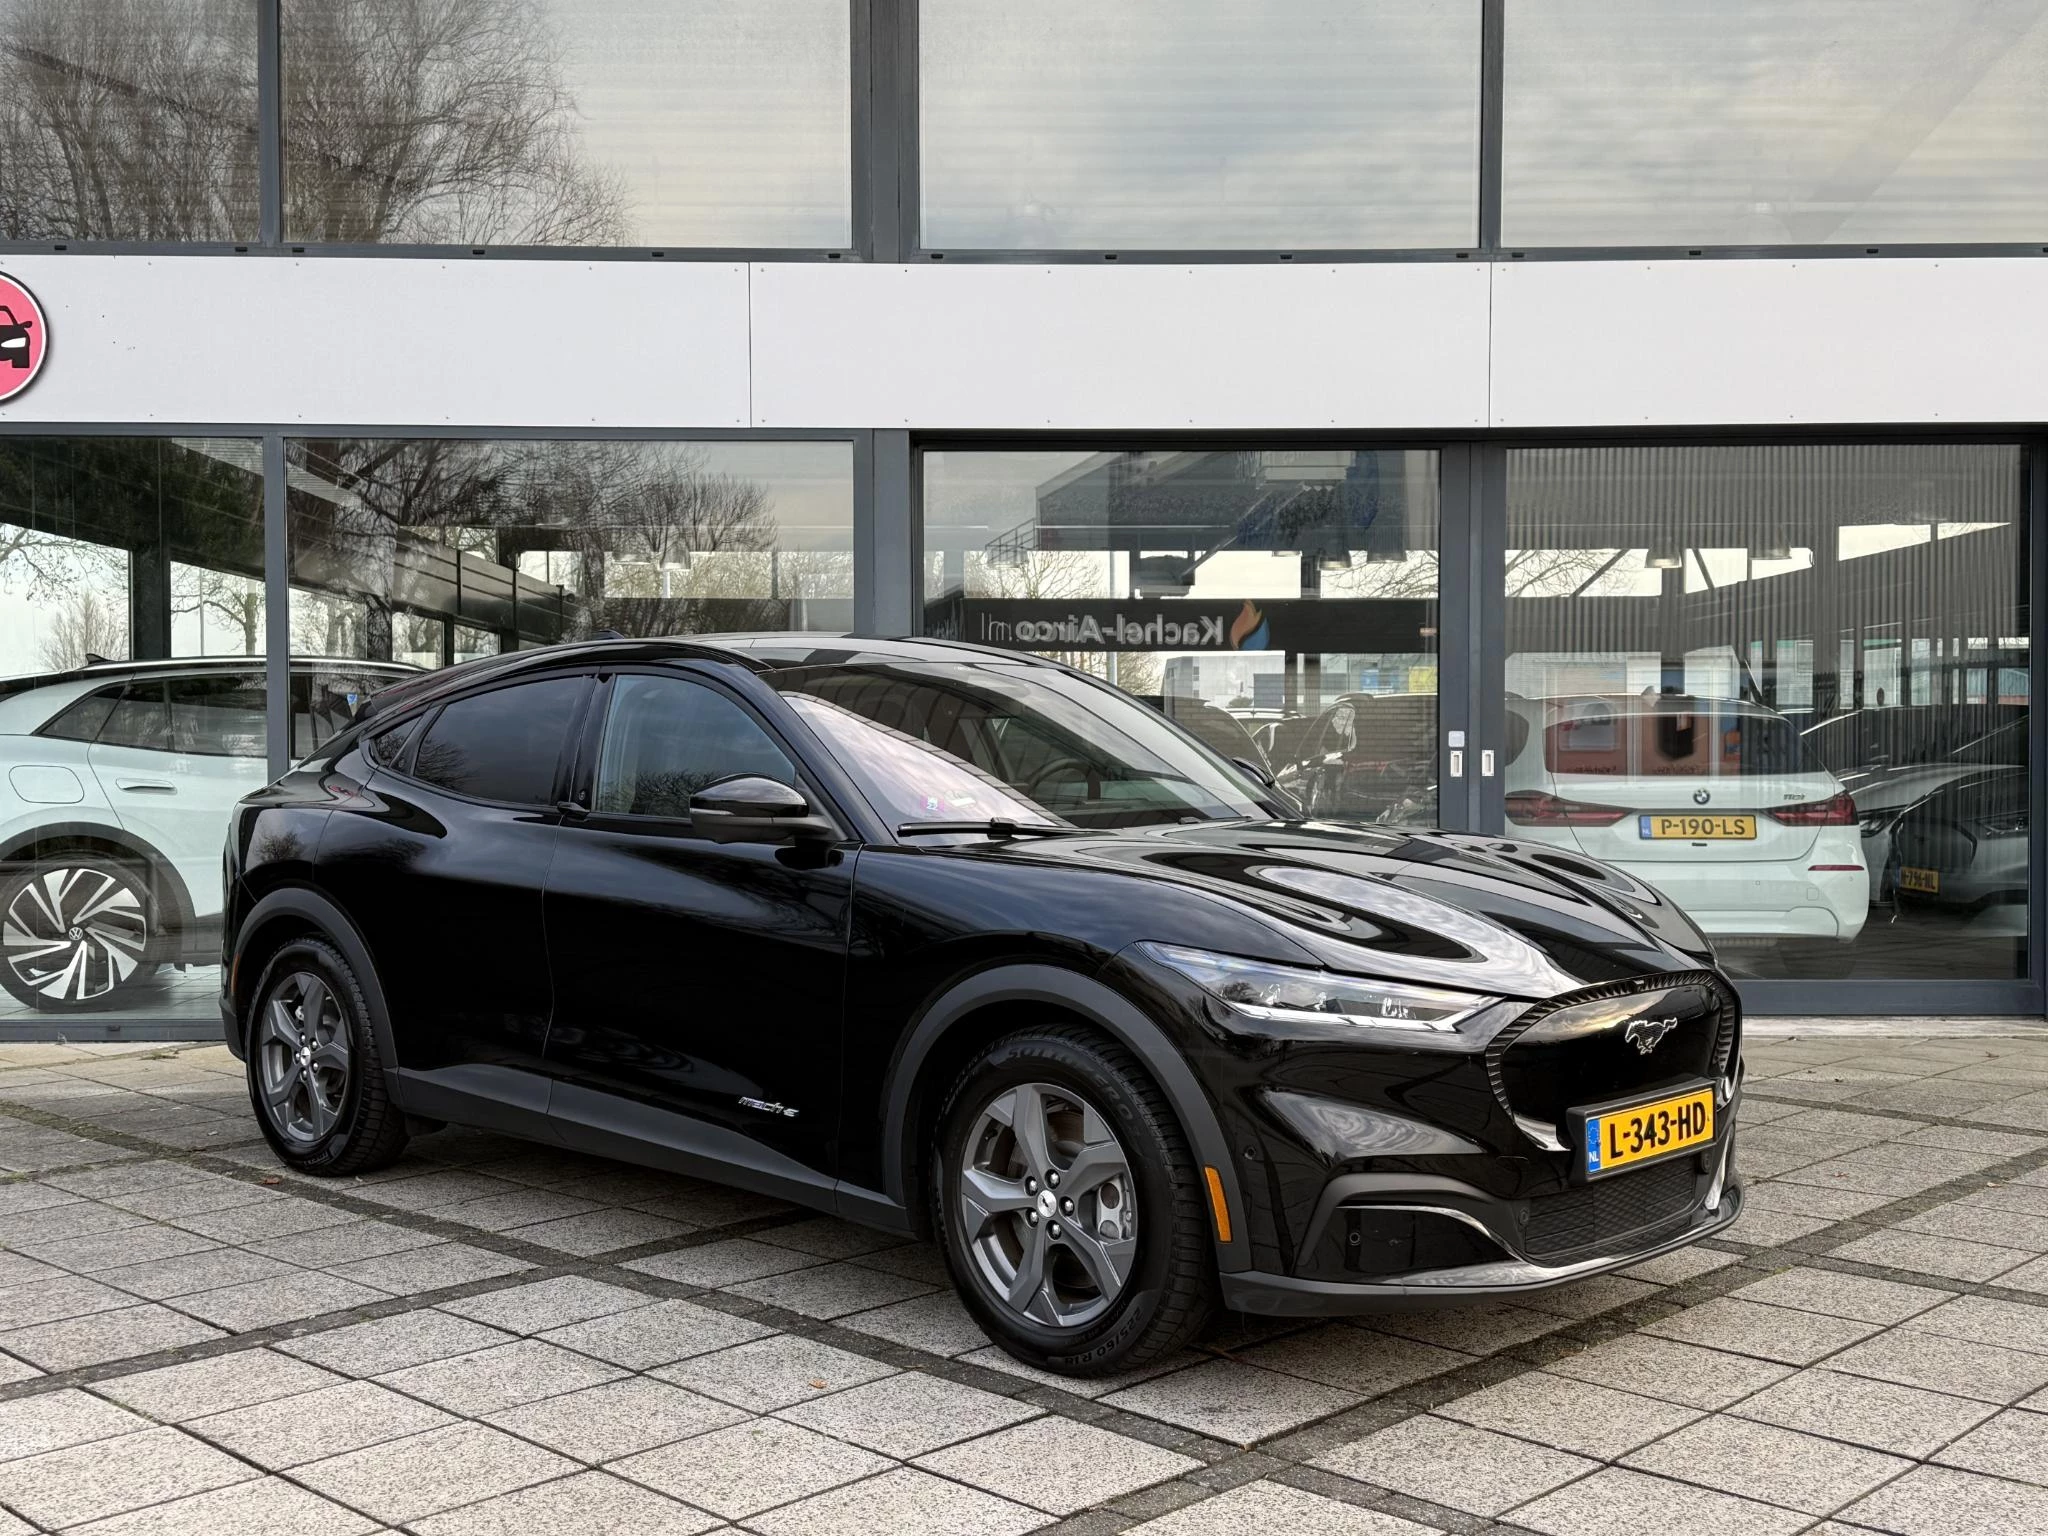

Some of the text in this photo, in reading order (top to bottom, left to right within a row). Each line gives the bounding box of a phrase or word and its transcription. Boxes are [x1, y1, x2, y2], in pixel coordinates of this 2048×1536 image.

[1660, 818, 1746, 835] P-190-LS
[1588, 1101, 1706, 1162] NL L-343-HD
